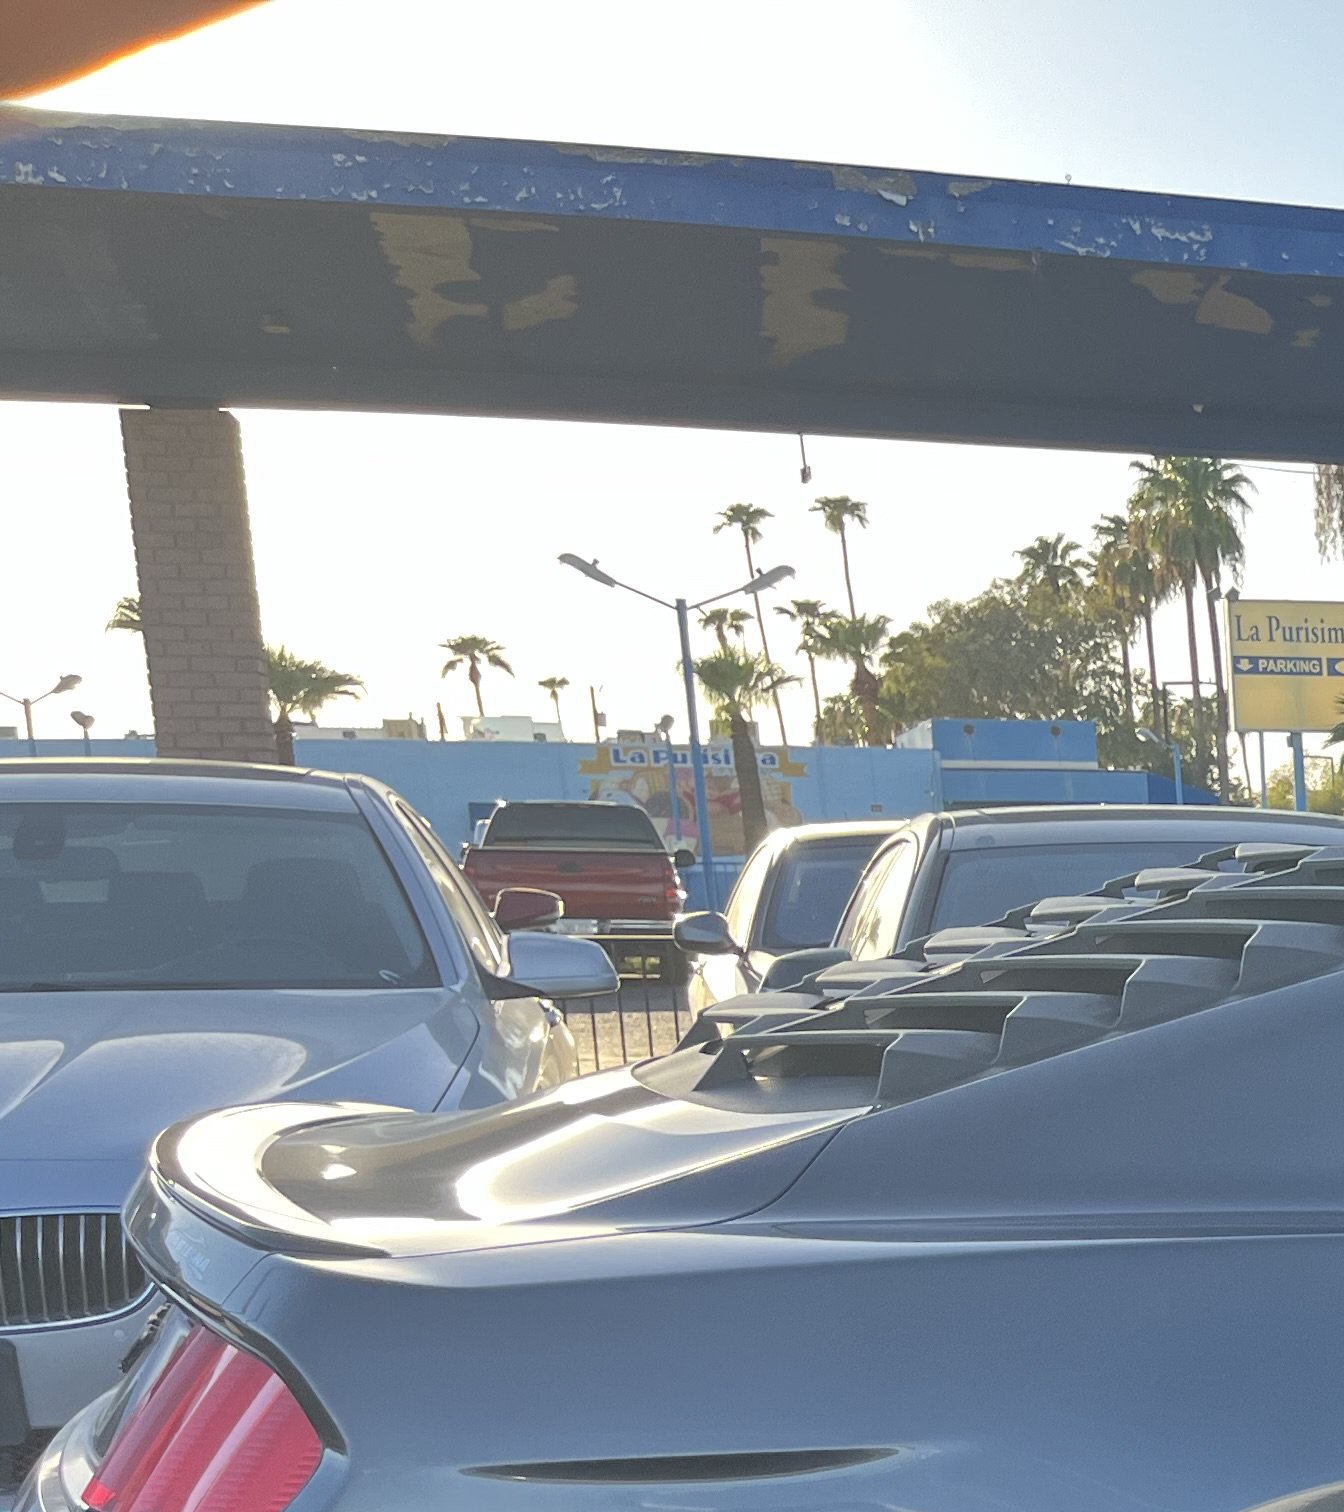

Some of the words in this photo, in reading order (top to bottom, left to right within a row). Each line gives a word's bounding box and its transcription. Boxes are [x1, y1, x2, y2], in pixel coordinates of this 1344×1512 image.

[1234, 614, 1261, 642] La
[1258, 658, 1320, 674] PARKING
[612, 748, 646, 765] La
[652, 748, 777, 766] Puisia
